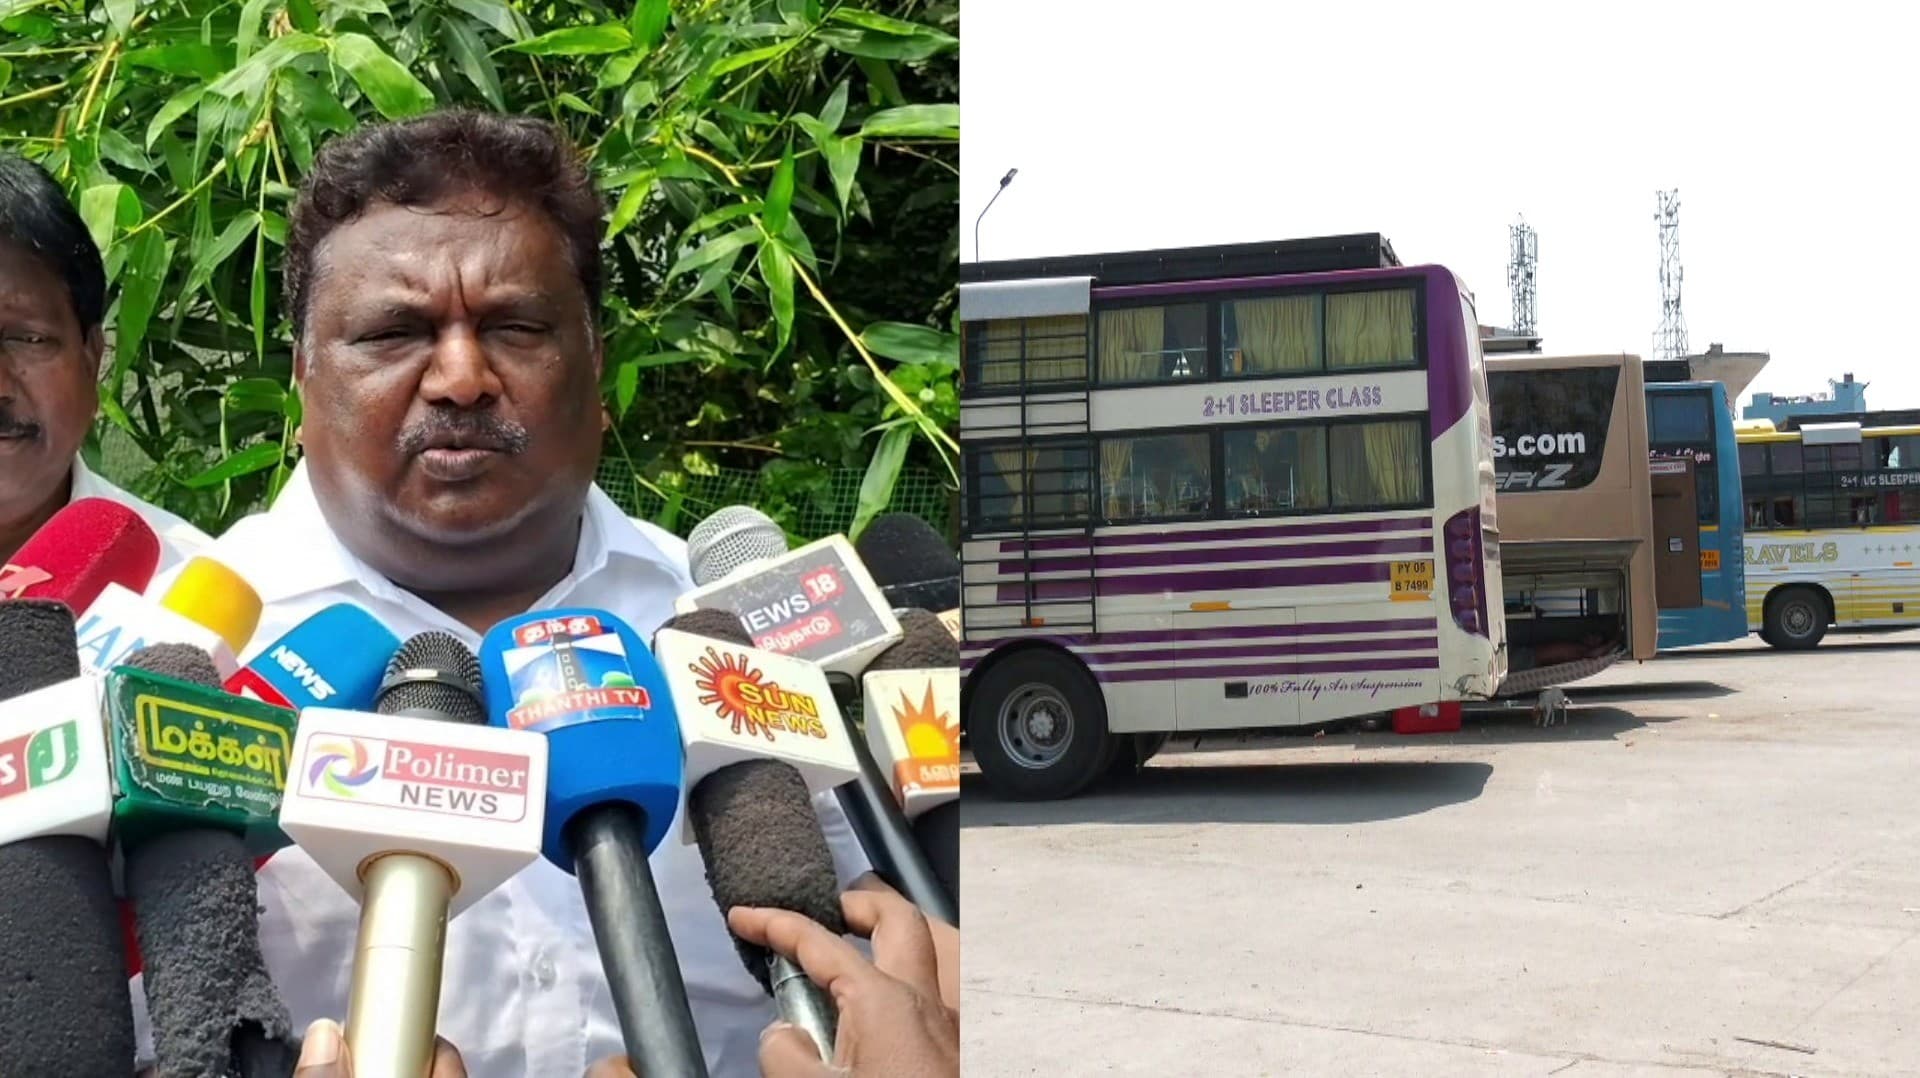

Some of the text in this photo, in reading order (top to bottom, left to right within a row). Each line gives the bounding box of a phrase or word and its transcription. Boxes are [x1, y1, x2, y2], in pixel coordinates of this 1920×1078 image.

[1203, 386, 1383, 417] 2+1 SLEEPER CLASS
[1413, 561, 1426, 574] 05
[804, 572, 838, 599] 18
[269, 644, 337, 701] NEWS
[1249, 677, 1424, 700] 100% Fully Air Suspension
[514, 689, 640, 725] THANTHI TV
[738, 681, 819, 717] SUN
[744, 704, 827, 739] NEWS
[151, 704, 284, 788] மக்கள்
[385, 745, 526, 790] Polimer
[400, 783, 499, 815] NEWS
